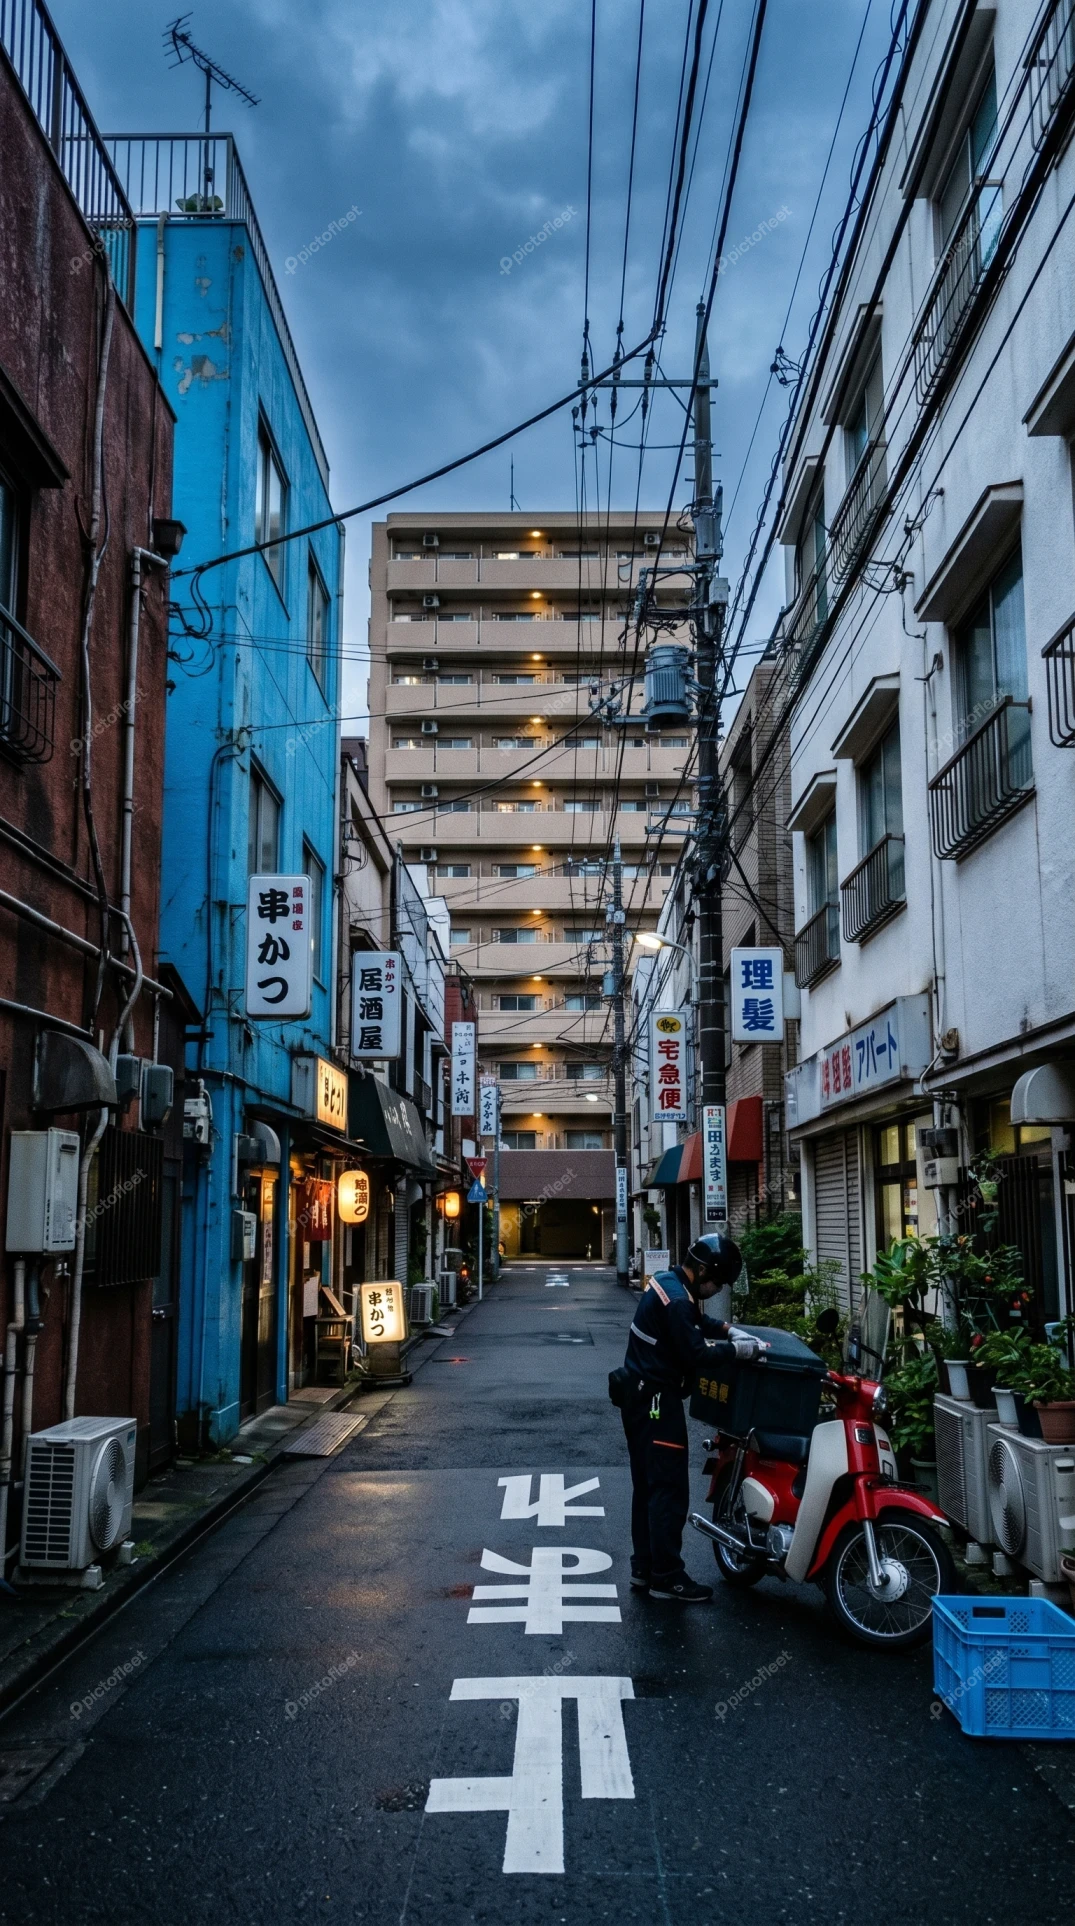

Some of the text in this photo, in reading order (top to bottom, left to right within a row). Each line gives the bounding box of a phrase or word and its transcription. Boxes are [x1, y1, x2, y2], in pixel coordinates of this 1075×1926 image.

[257, 888, 290, 1004] 串かつ
[384, 958, 395, 993] 串かつ
[358, 967, 383, 1050] 居酒屋
[741, 959, 775, 1031] 理髪
[658, 1039, 682, 1110] 宅急便
[368, 1291, 384, 1336] 串かつ
